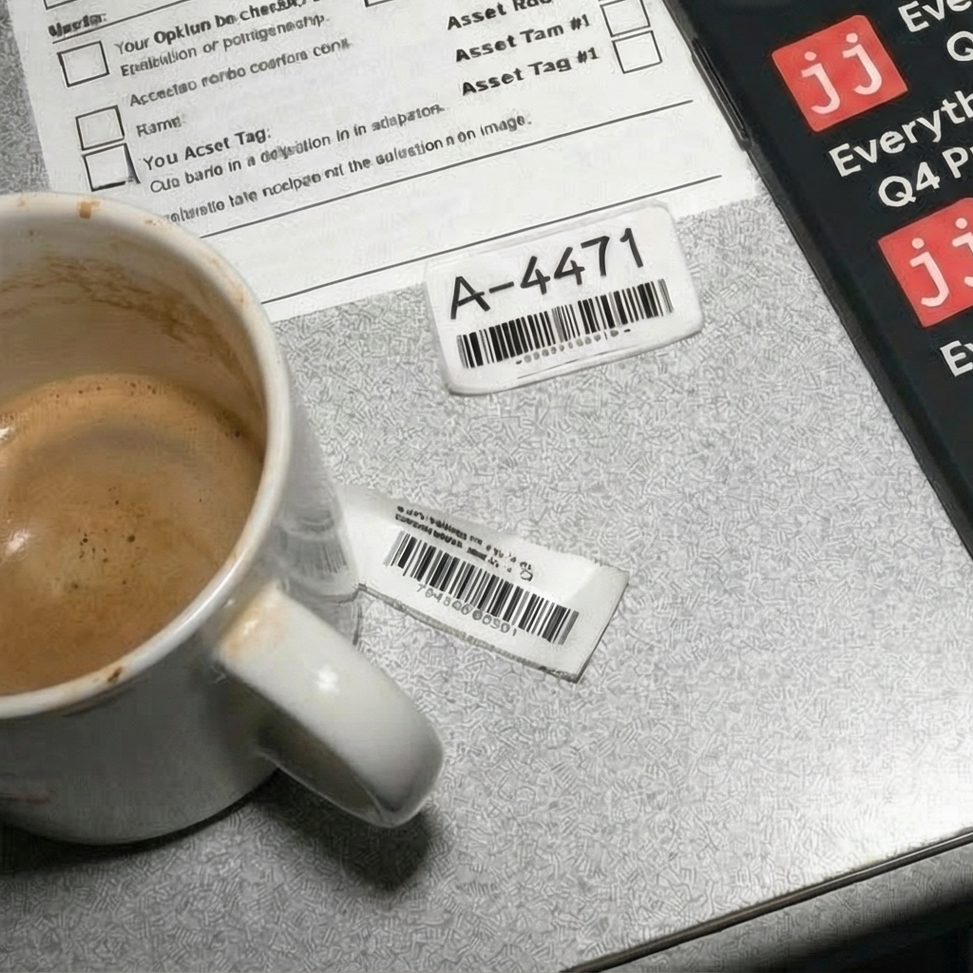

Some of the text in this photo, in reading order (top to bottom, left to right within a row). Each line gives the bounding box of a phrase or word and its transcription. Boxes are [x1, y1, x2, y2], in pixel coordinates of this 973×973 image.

[447, 2, 507, 30] Asset
[455, 13, 590, 63] Asset Tam #1
[114, 37, 149, 55] Your
[462, 47, 600, 96] Asset Tag #1
[143, 152, 178, 171] You
[234, 128, 271, 145] Tag:
[878, 162, 941, 208] Q4
[451, 227, 644, 320] A-4471
